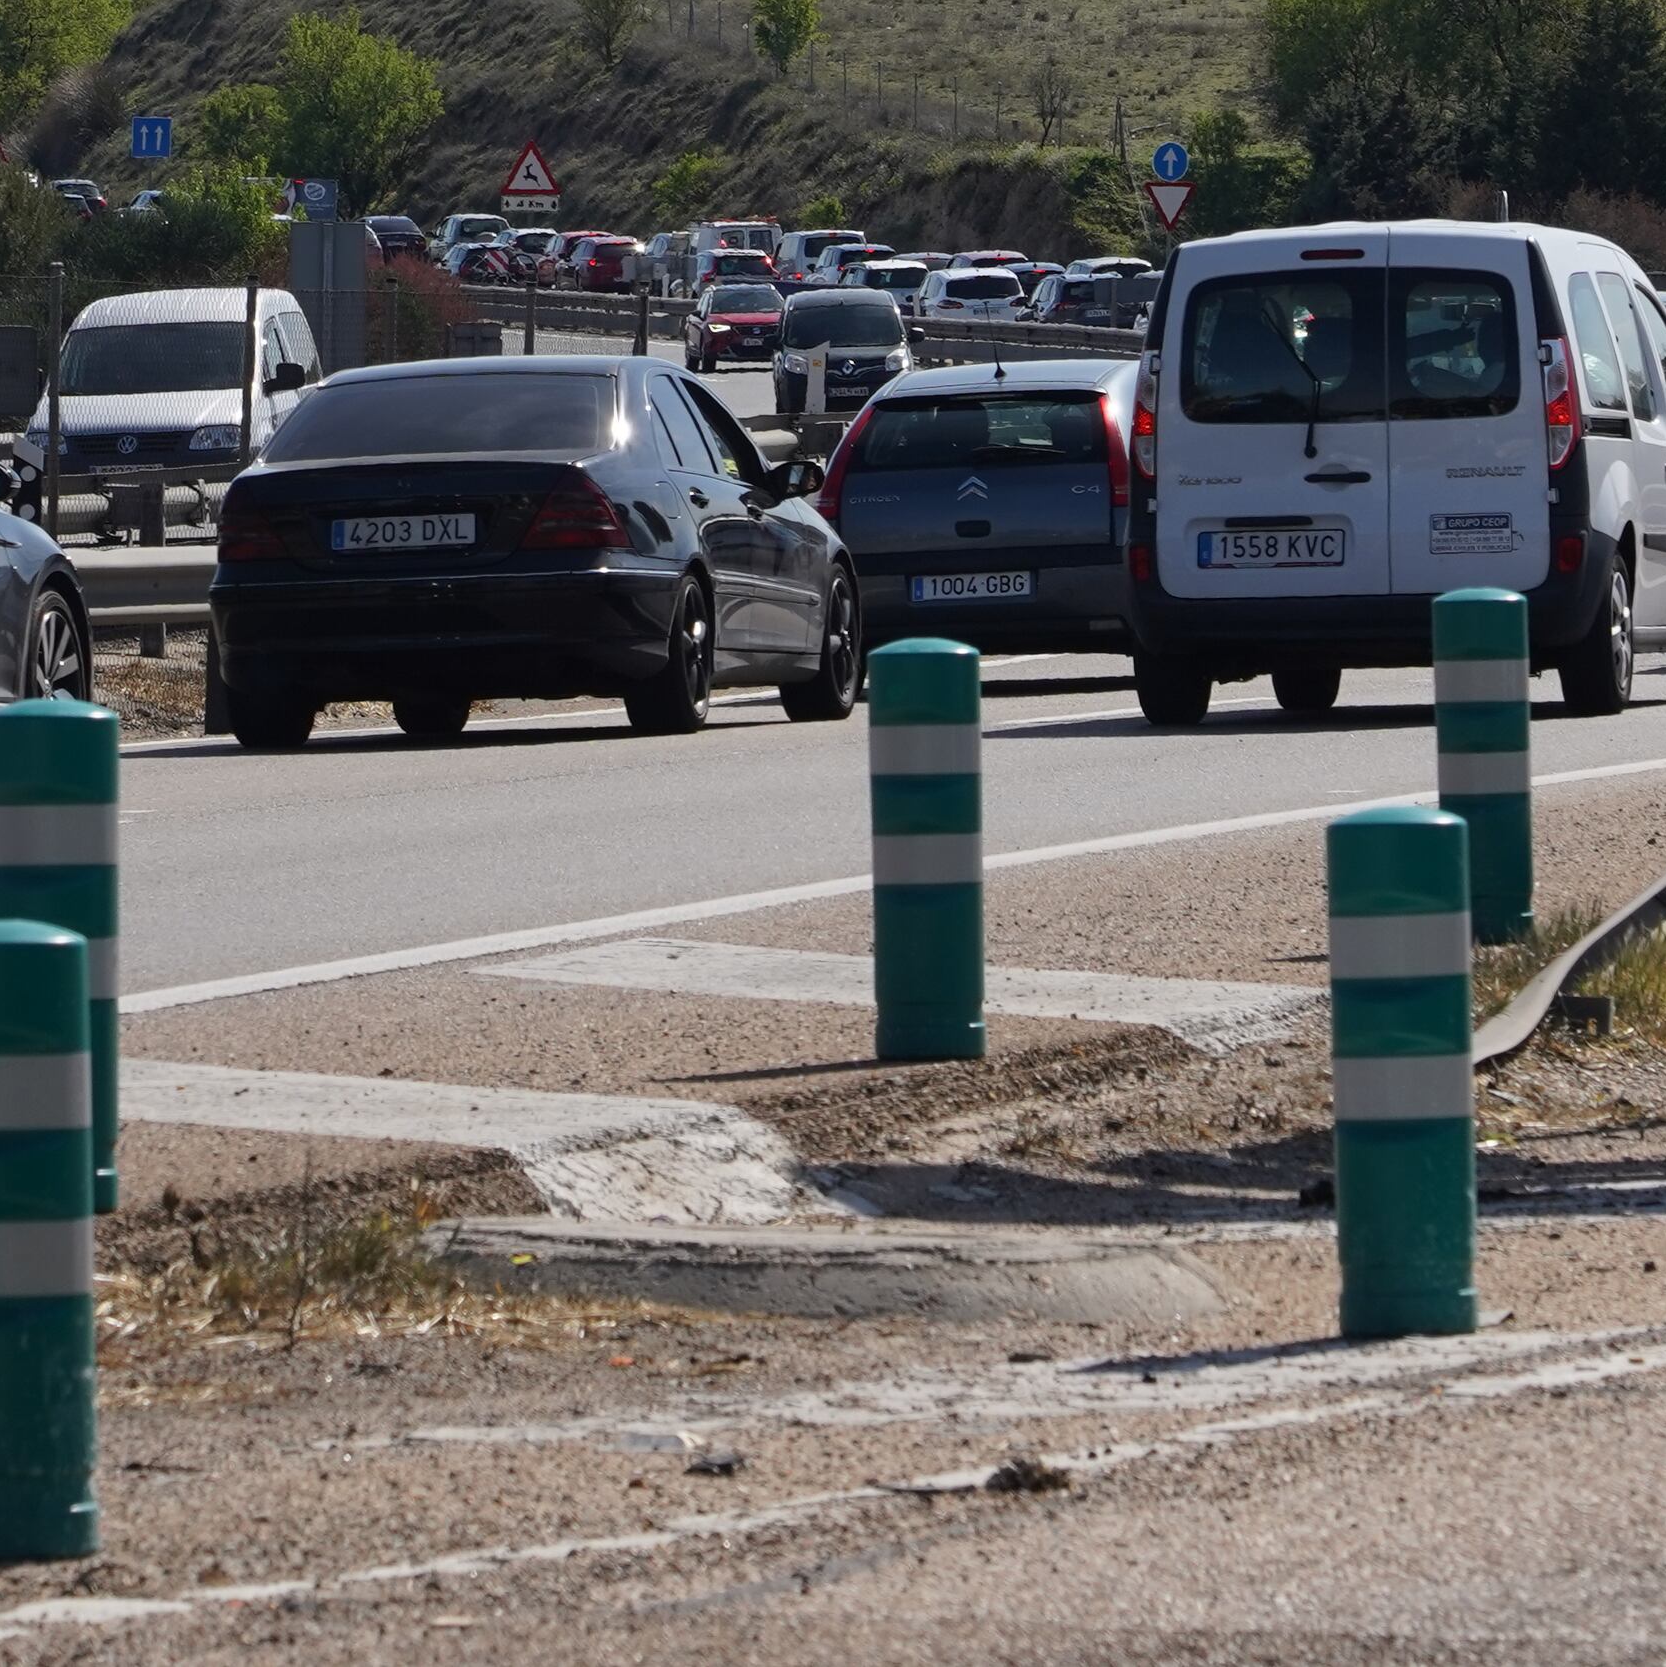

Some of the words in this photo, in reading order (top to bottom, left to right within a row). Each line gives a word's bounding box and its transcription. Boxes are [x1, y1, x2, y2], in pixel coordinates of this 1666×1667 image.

[1446, 466, 1525, 478] RENAULT
[1071, 485, 1101, 494] C4
[350, 521, 411, 545] 4203
[422, 518, 468, 541] DXL
[1448, 518, 1480, 528] GRUPO
[1220, 536, 1278, 559] 1558
[1288, 535, 1335, 558] KVC
[931, 576, 977, 596] 1004
[985, 574, 1026, 594] GBG
